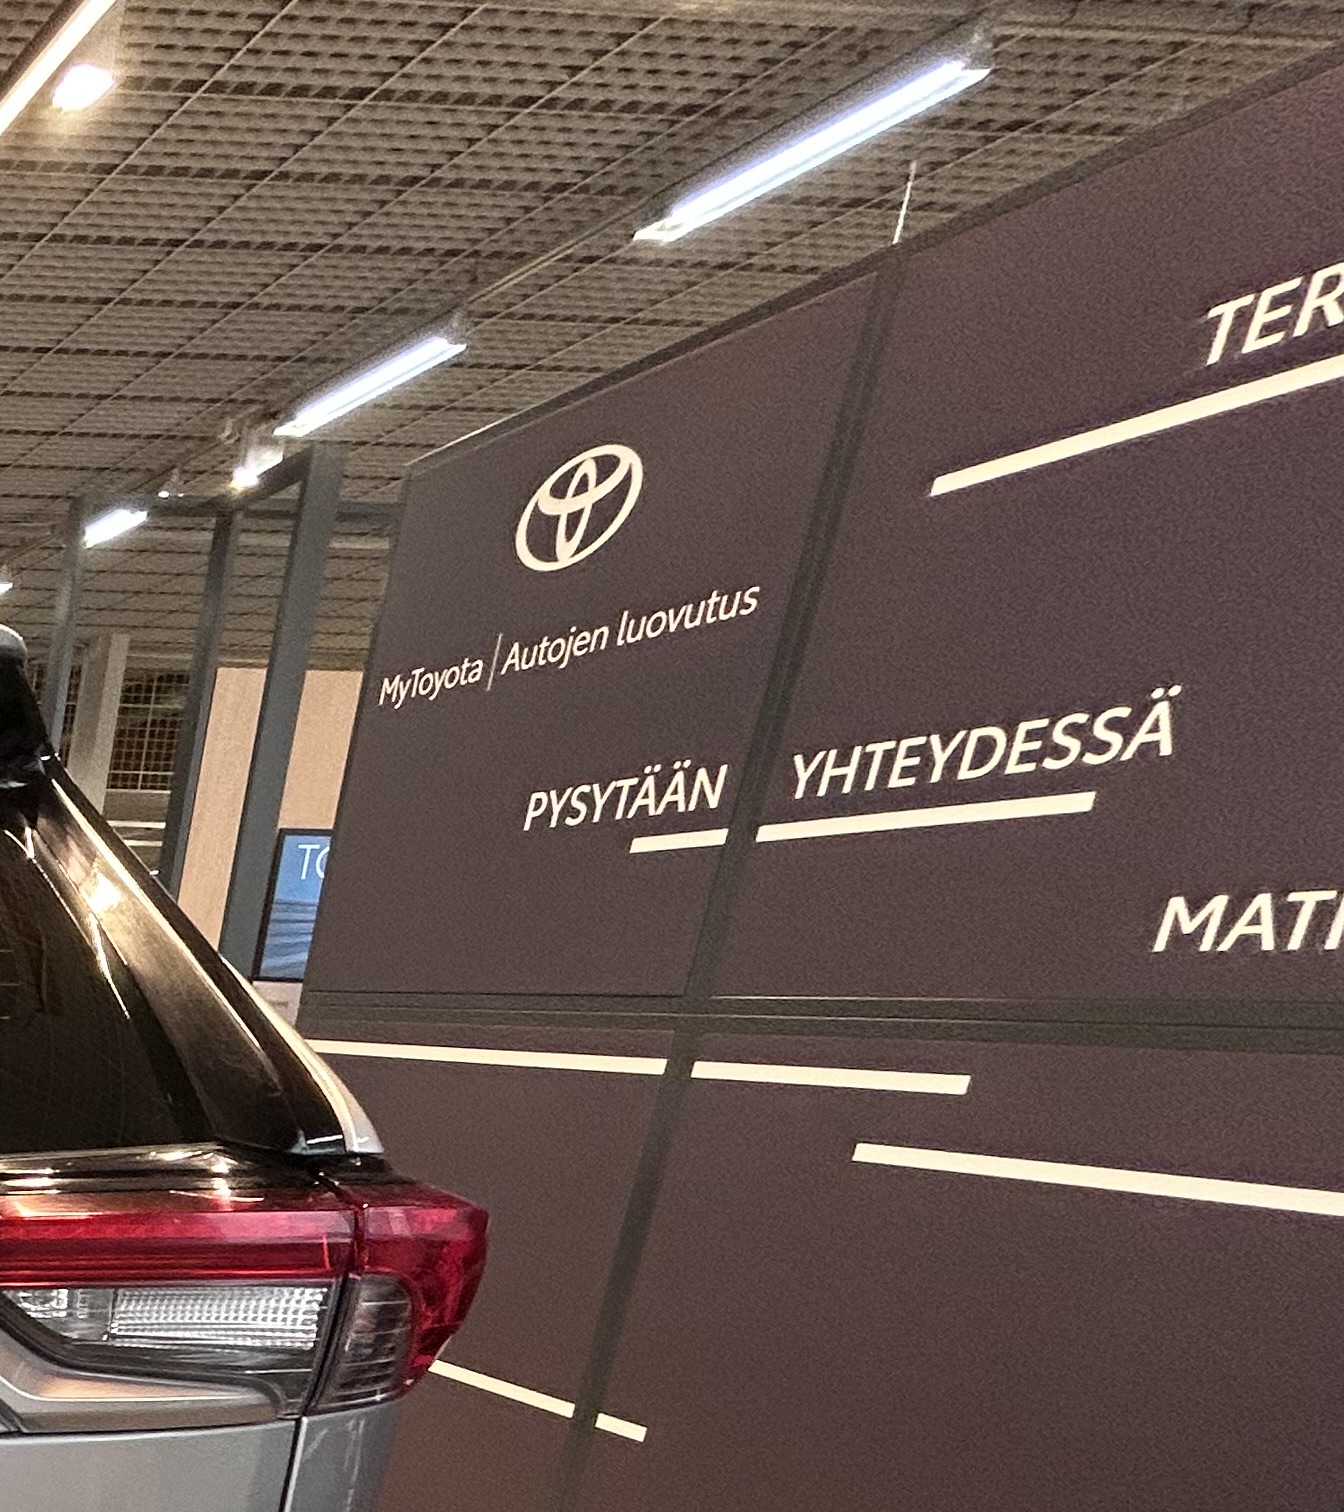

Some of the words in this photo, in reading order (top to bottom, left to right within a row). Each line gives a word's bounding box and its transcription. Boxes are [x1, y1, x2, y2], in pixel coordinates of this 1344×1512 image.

[379, 657, 484, 709] MyToyota
[500, 623, 610, 675] Autojen
[615, 585, 760, 646] luovutus
[523, 759, 728, 831] PYSYTÄÄN
[791, 684, 1182, 800] YHTEYDESSÄ
